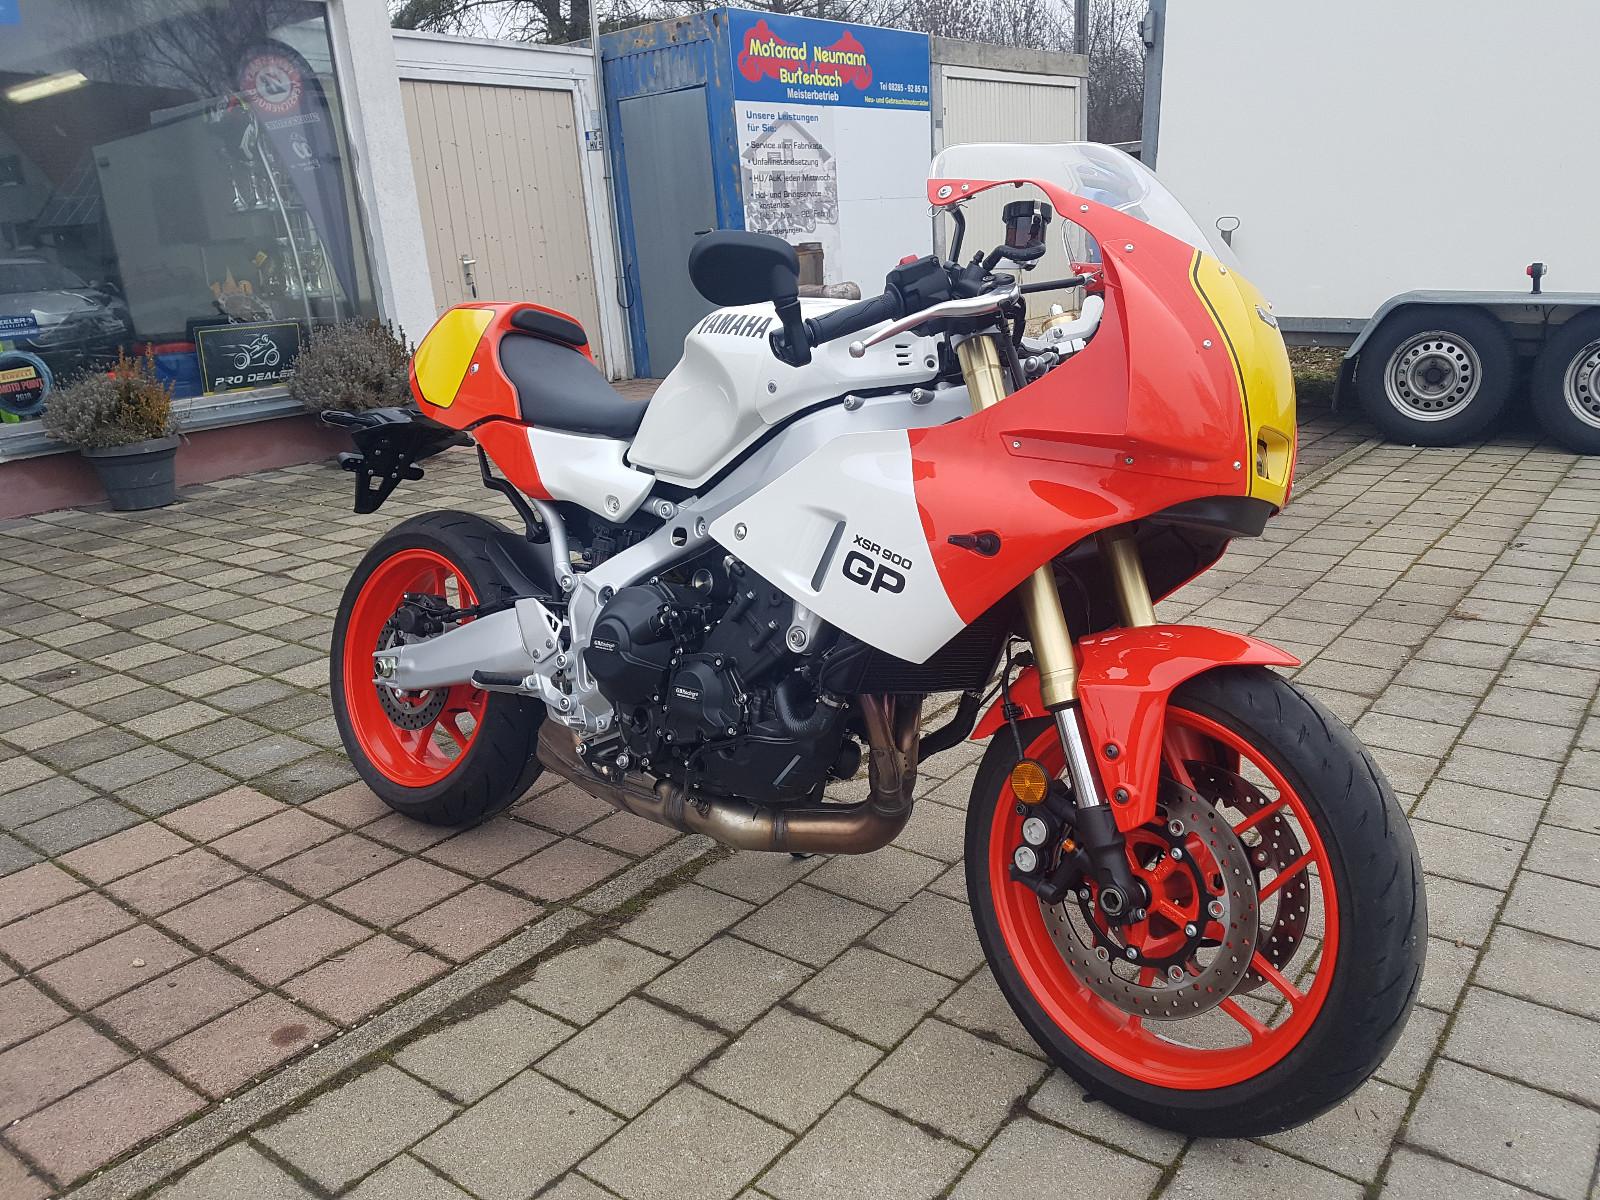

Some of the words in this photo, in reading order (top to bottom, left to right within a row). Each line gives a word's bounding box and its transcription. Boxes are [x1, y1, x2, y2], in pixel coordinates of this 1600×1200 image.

[749, 38, 807, 60] Motorrad
[813, 46, 866, 66] Neumann
[780, 67, 842, 87] Burtenbach
[880, 81, 888, 91] Tel
[786, 87, 839, 101] Meisterbetrieb
[746, 110, 775, 120] Unsere
[777, 111, 819, 123] Leistungen
[747, 122, 760, 132] für
[762, 123, 777, 133] Sie:
[751, 141, 775, 149] Service
[793, 141, 823, 150] Fabrikate
[752, 158, 819, 167] Unfallinstandsetzung
[783, 174, 801, 183] jeden
[802, 173, 831, 182] Mittwoch
[769, 191, 782, 199] und
[783, 190, 822, 199] Bringservice
[759, 201, 790, 209] kostenlos
[697, 313, 773, 339] YAMAHA
[215, 375, 243, 386] PRO
[247, 369, 296, 383] DEALER
[842, 550, 906, 594] GP
